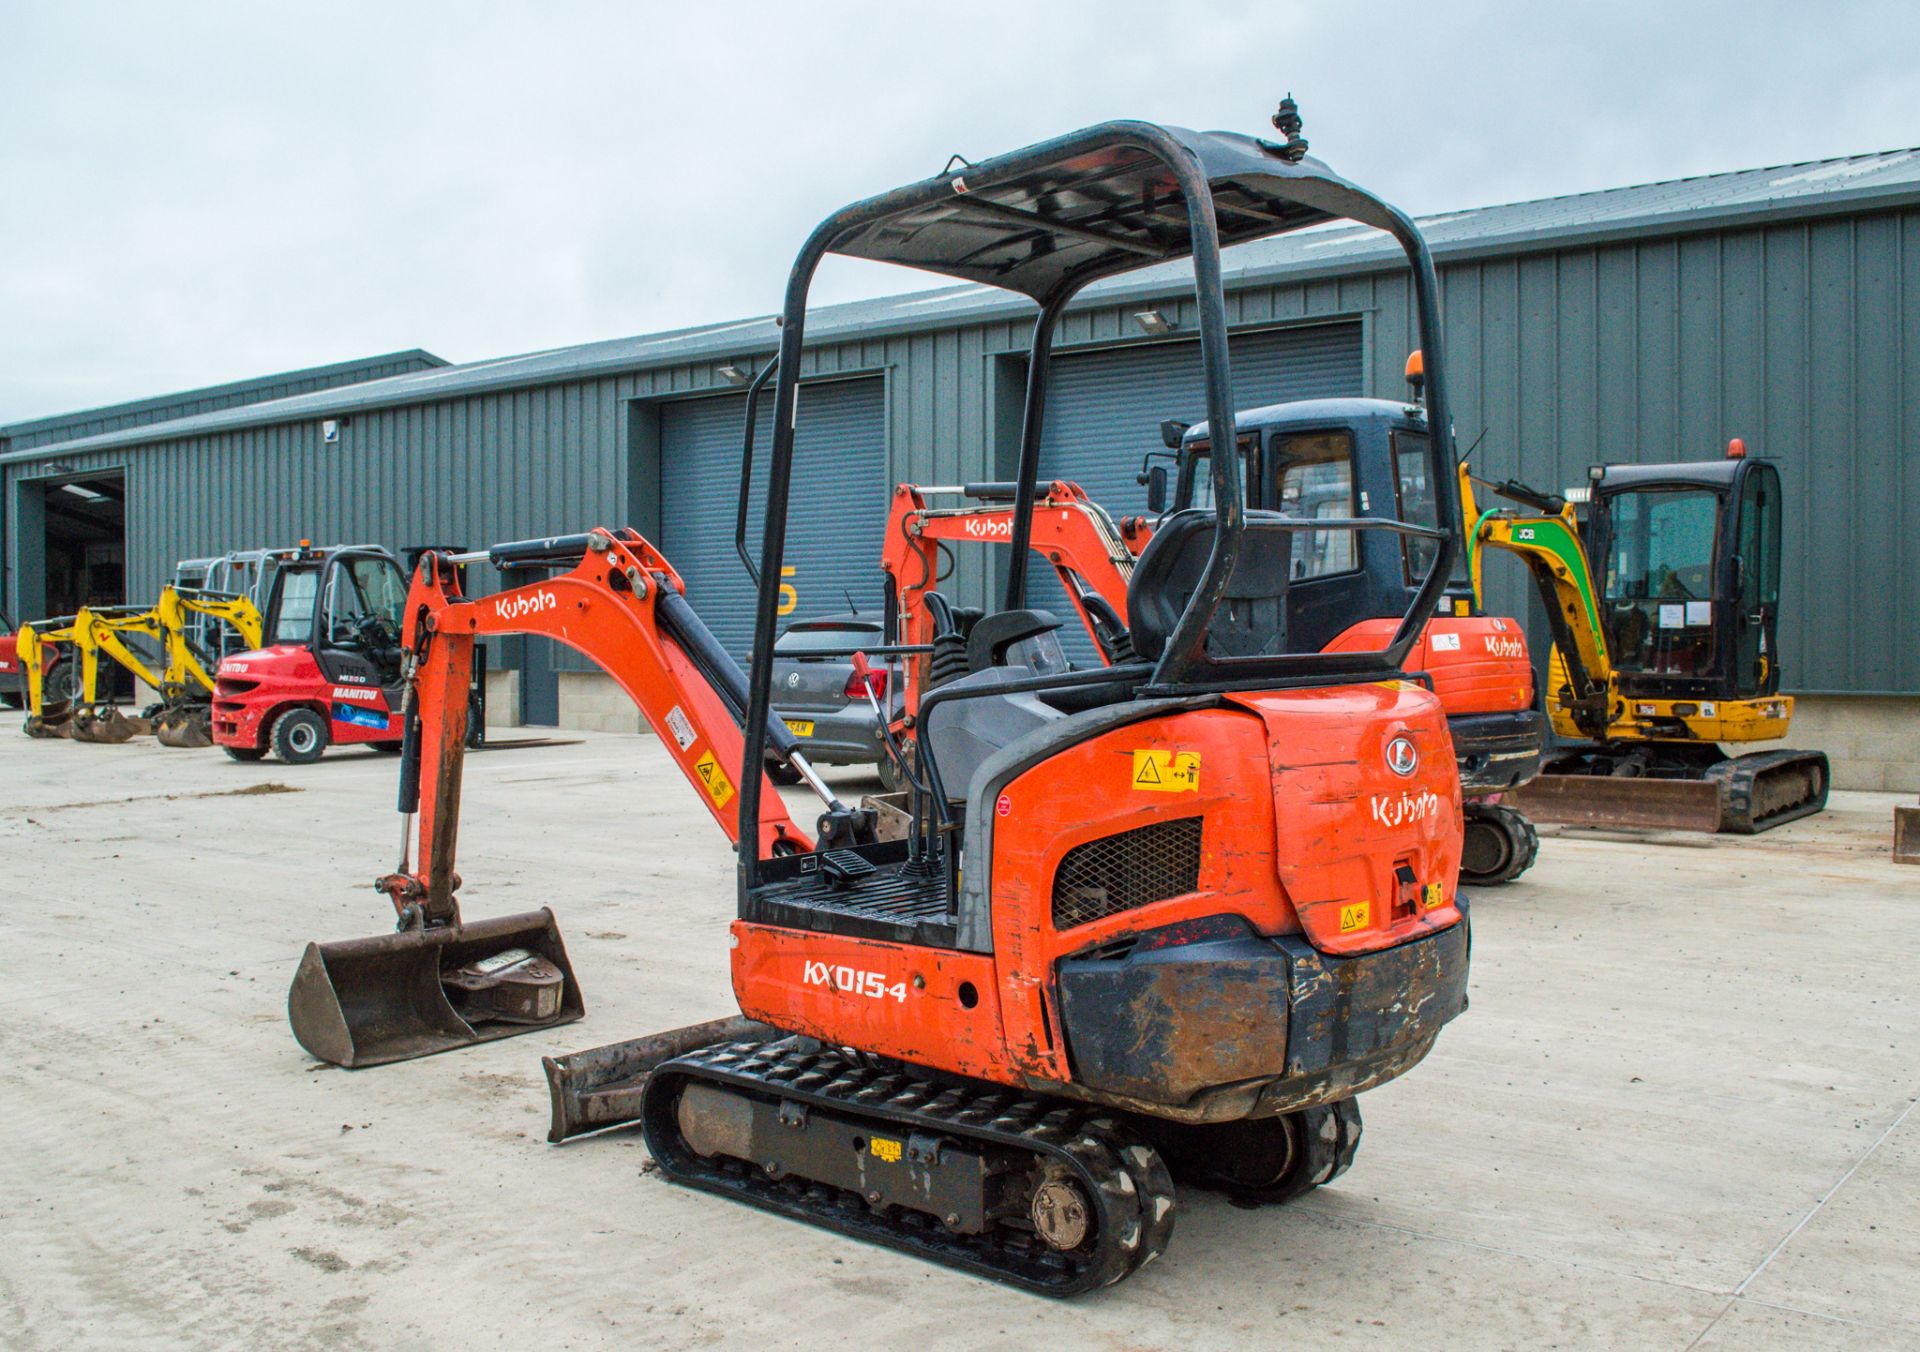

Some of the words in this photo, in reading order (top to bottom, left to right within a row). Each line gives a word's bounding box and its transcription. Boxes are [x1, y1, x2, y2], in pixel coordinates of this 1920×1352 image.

[965, 517, 1014, 536] Kubot
[1519, 528, 1535, 540] JCB
[495, 588, 556, 620] Kubota
[1484, 634, 1523, 658] Kubota
[332, 687, 378, 701] MANITOU
